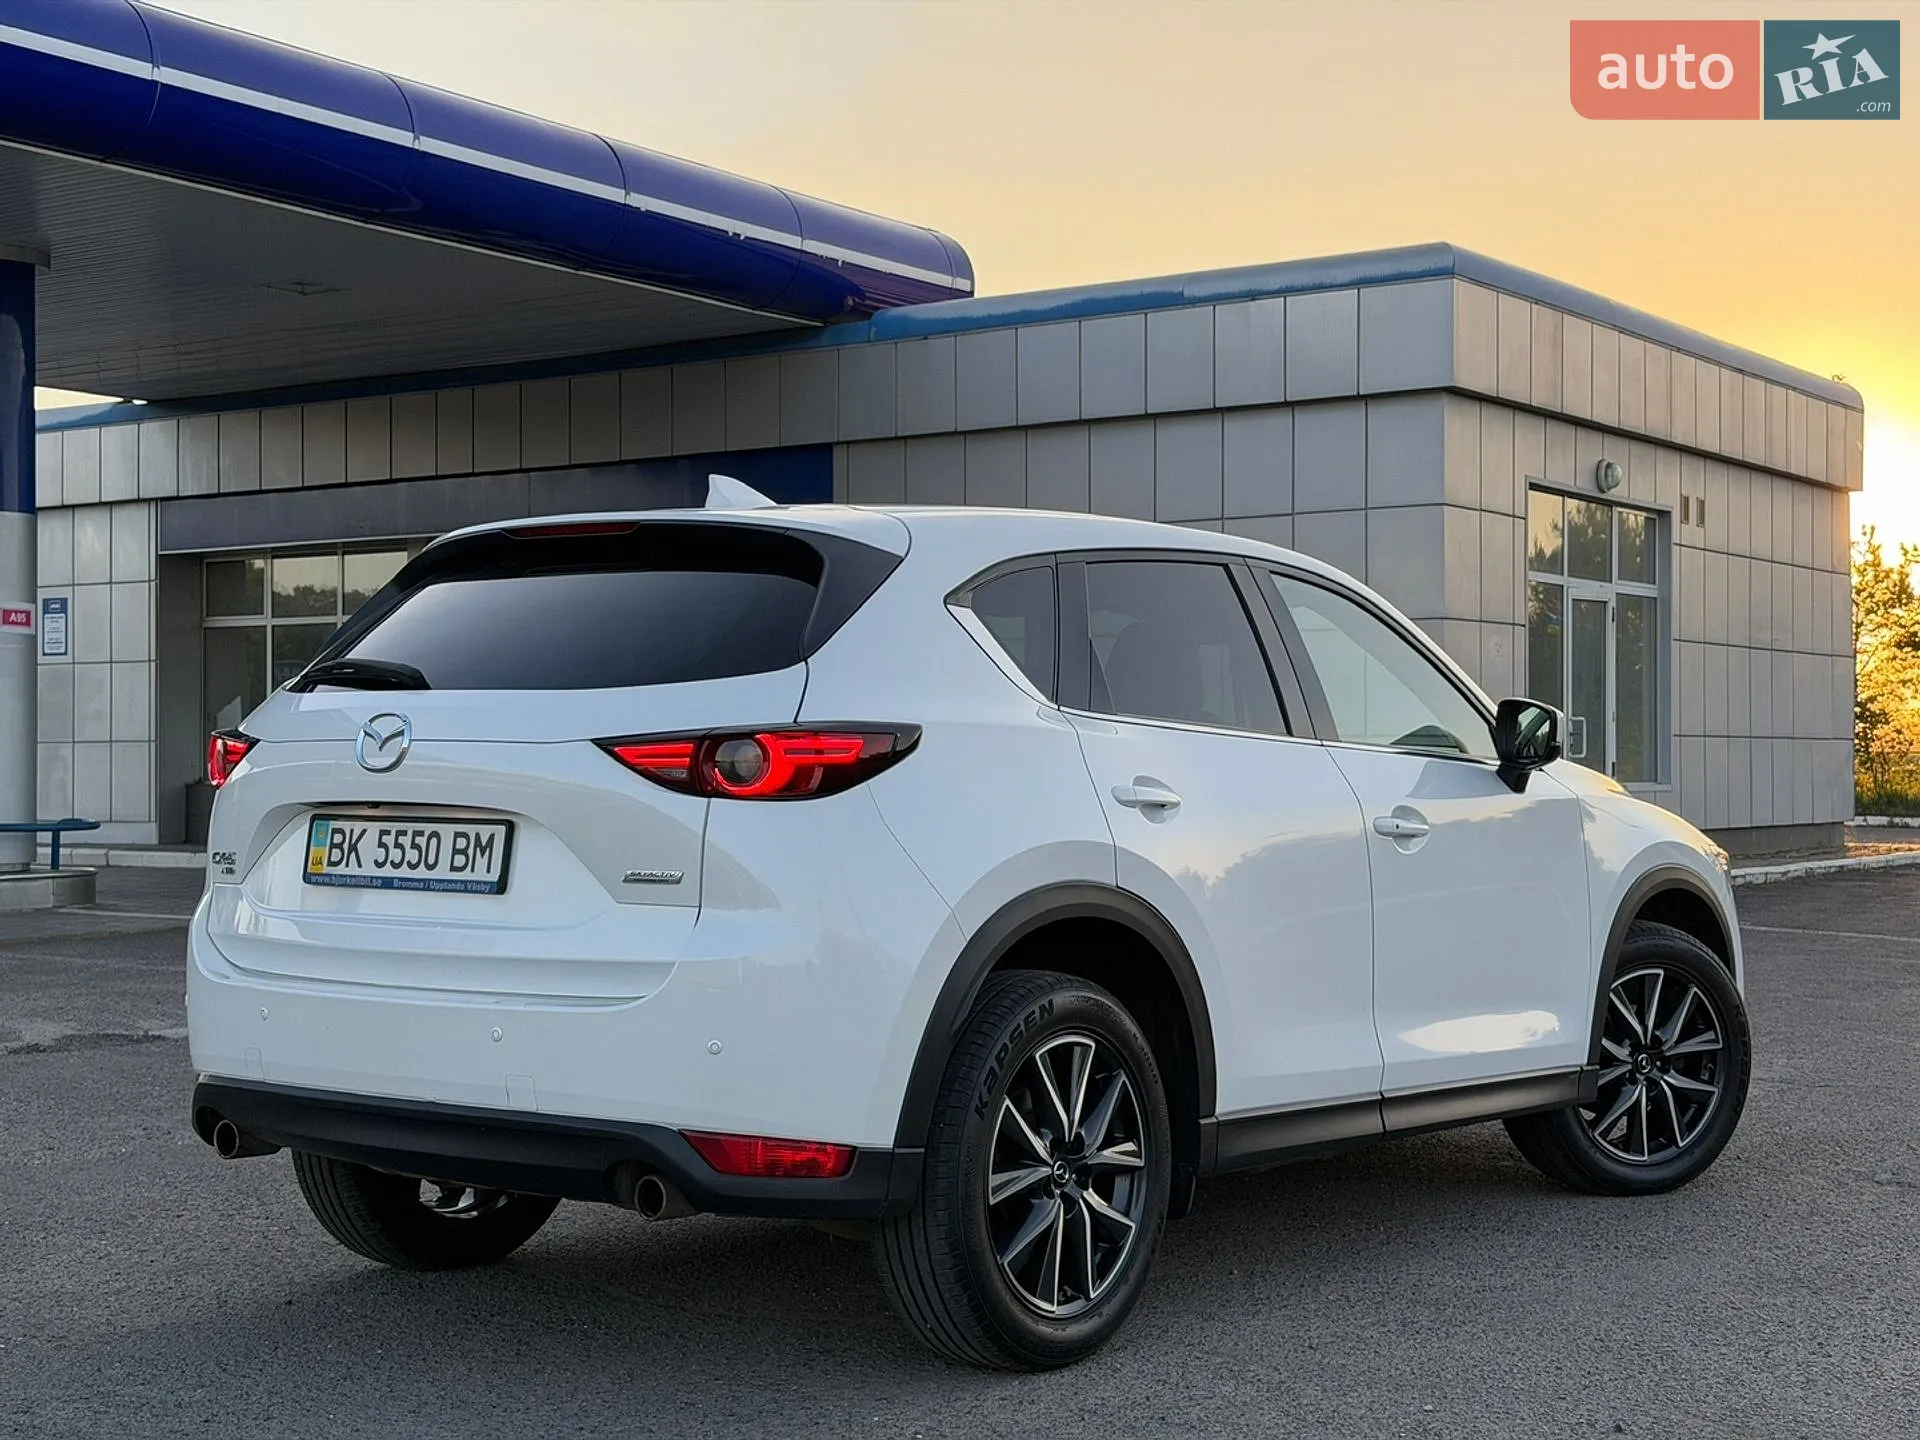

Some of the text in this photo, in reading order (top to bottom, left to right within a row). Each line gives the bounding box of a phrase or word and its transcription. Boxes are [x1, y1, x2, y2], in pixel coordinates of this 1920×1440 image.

[311, 856, 324, 867] UA
[326, 827, 495, 874] BK 5550 BM
